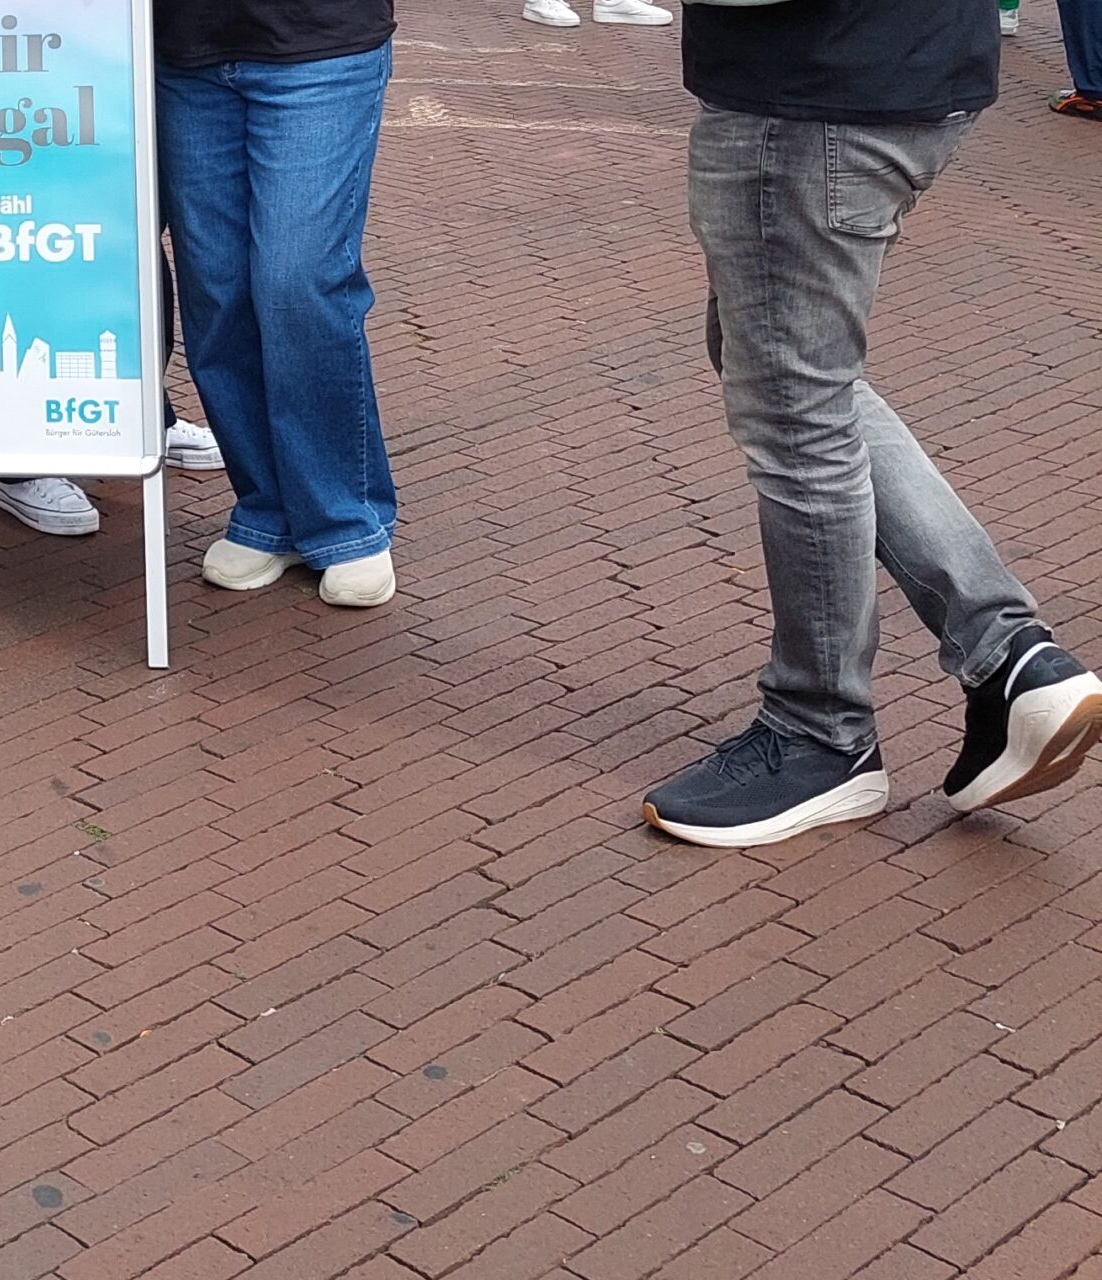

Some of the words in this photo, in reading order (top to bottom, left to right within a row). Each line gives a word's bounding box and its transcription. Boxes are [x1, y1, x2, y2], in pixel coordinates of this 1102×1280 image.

[45, 397, 120, 424] BfGT
[45, 428, 71, 438] Bürger
[84, 428, 121, 437] Gütersloh
